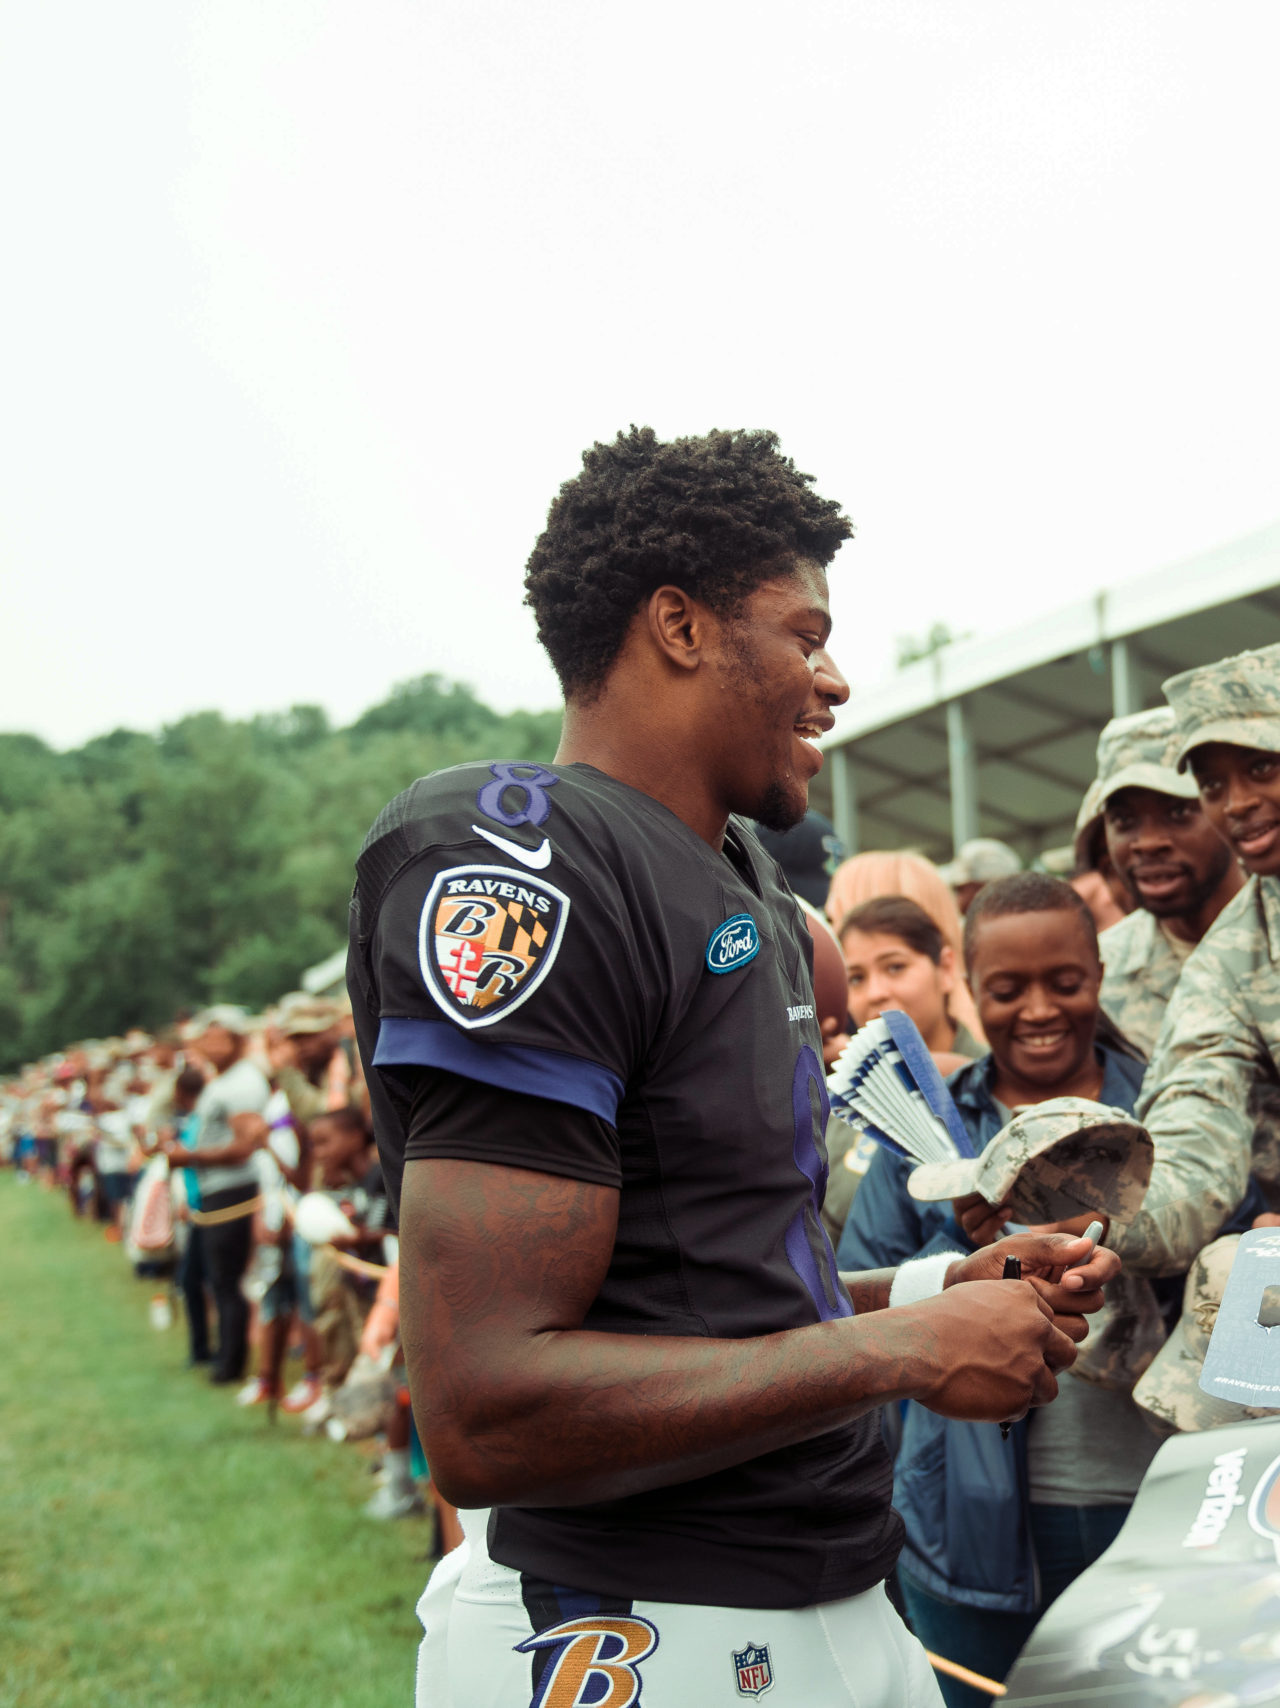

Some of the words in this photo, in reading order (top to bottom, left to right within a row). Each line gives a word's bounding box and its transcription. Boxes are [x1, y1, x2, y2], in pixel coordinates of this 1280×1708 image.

[477, 763, 560, 828] 8
[447, 879, 551, 913] RAVENS
[441, 899, 498, 939] B
[719, 926, 753, 963] Ford
[473, 951, 528, 997] R
[787, 1004, 815, 1022] RAVENS
[1181, 1446, 1249, 1548] verizon
[512, 1613, 661, 1708] B
[738, 1664, 771, 1691] NFL
